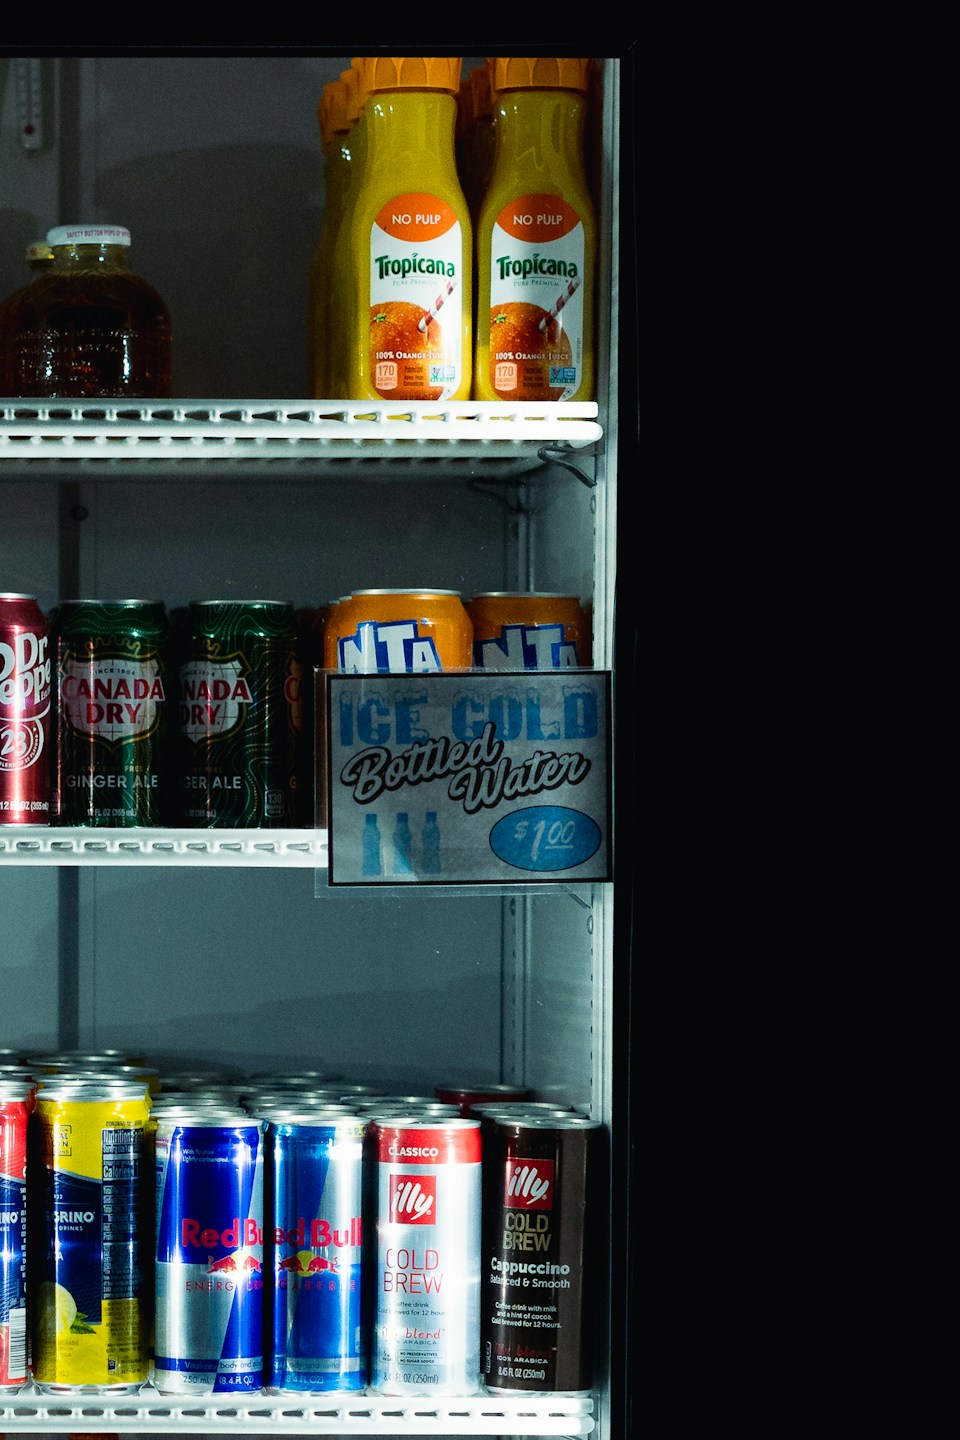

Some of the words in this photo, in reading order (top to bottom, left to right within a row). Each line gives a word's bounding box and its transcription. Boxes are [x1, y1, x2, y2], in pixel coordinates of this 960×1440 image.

[392, 214, 412, 225] NO
[416, 213, 441, 225] PULP
[513, 215, 533, 225] NO
[537, 214, 563, 225] PULP
[375, 253, 455, 279] Tropicana
[496, 253, 578, 280] Tropicana
[379, 365, 395, 376] 170
[497, 366, 514, 377] 170
[16, 632, 48, 671] Dr
[338, 621, 442, 673] NTA
[62, 675, 165, 700] CANADA
[183, 679, 251, 701] NADA
[86, 703, 142, 724] DRY
[340, 689, 430, 746] ICE
[451, 685, 599, 740] COLD
[1, 729, 27, 756] 23
[340, 721, 504, 805] Bottled
[66, 775, 127, 788] GINGER
[132, 775, 158, 788] ALE
[212, 776, 242, 789] ALE
[448, 751, 591, 814] Water
[388, 1147, 439, 1158] CLASSICO
[507, 1165, 550, 1205] illy
[391, 1181, 433, 1221] illy
[182, 1218, 239, 1248] Red
[244, 1218, 264, 1248] Bu
[272, 1218, 305, 1247] ed
[310, 1218, 363, 1248] Bull
[504, 1212, 549, 1233] COLD
[502, 1231, 552, 1251] BREW
[386, 1249, 439, 1271] COLD
[491, 1257, 570, 1276] Cappuccino
[185, 1281, 234, 1292] ENERG
[383, 1273, 444, 1294] BREW
[490, 1274, 520, 1286] Balanced
[522, 1277, 530, 1287] &
[532, 1277, 570, 1289] Smooth
[495, 1302, 511, 1310] Coffee
[491, 1317, 501, 1325] Cold
[502, 1319, 522, 1327] brewed
[406, 1327, 441, 1339] blend
[403, 1374, 412, 1383] OZ
[413, 1373, 439, 1384] (250ml)
